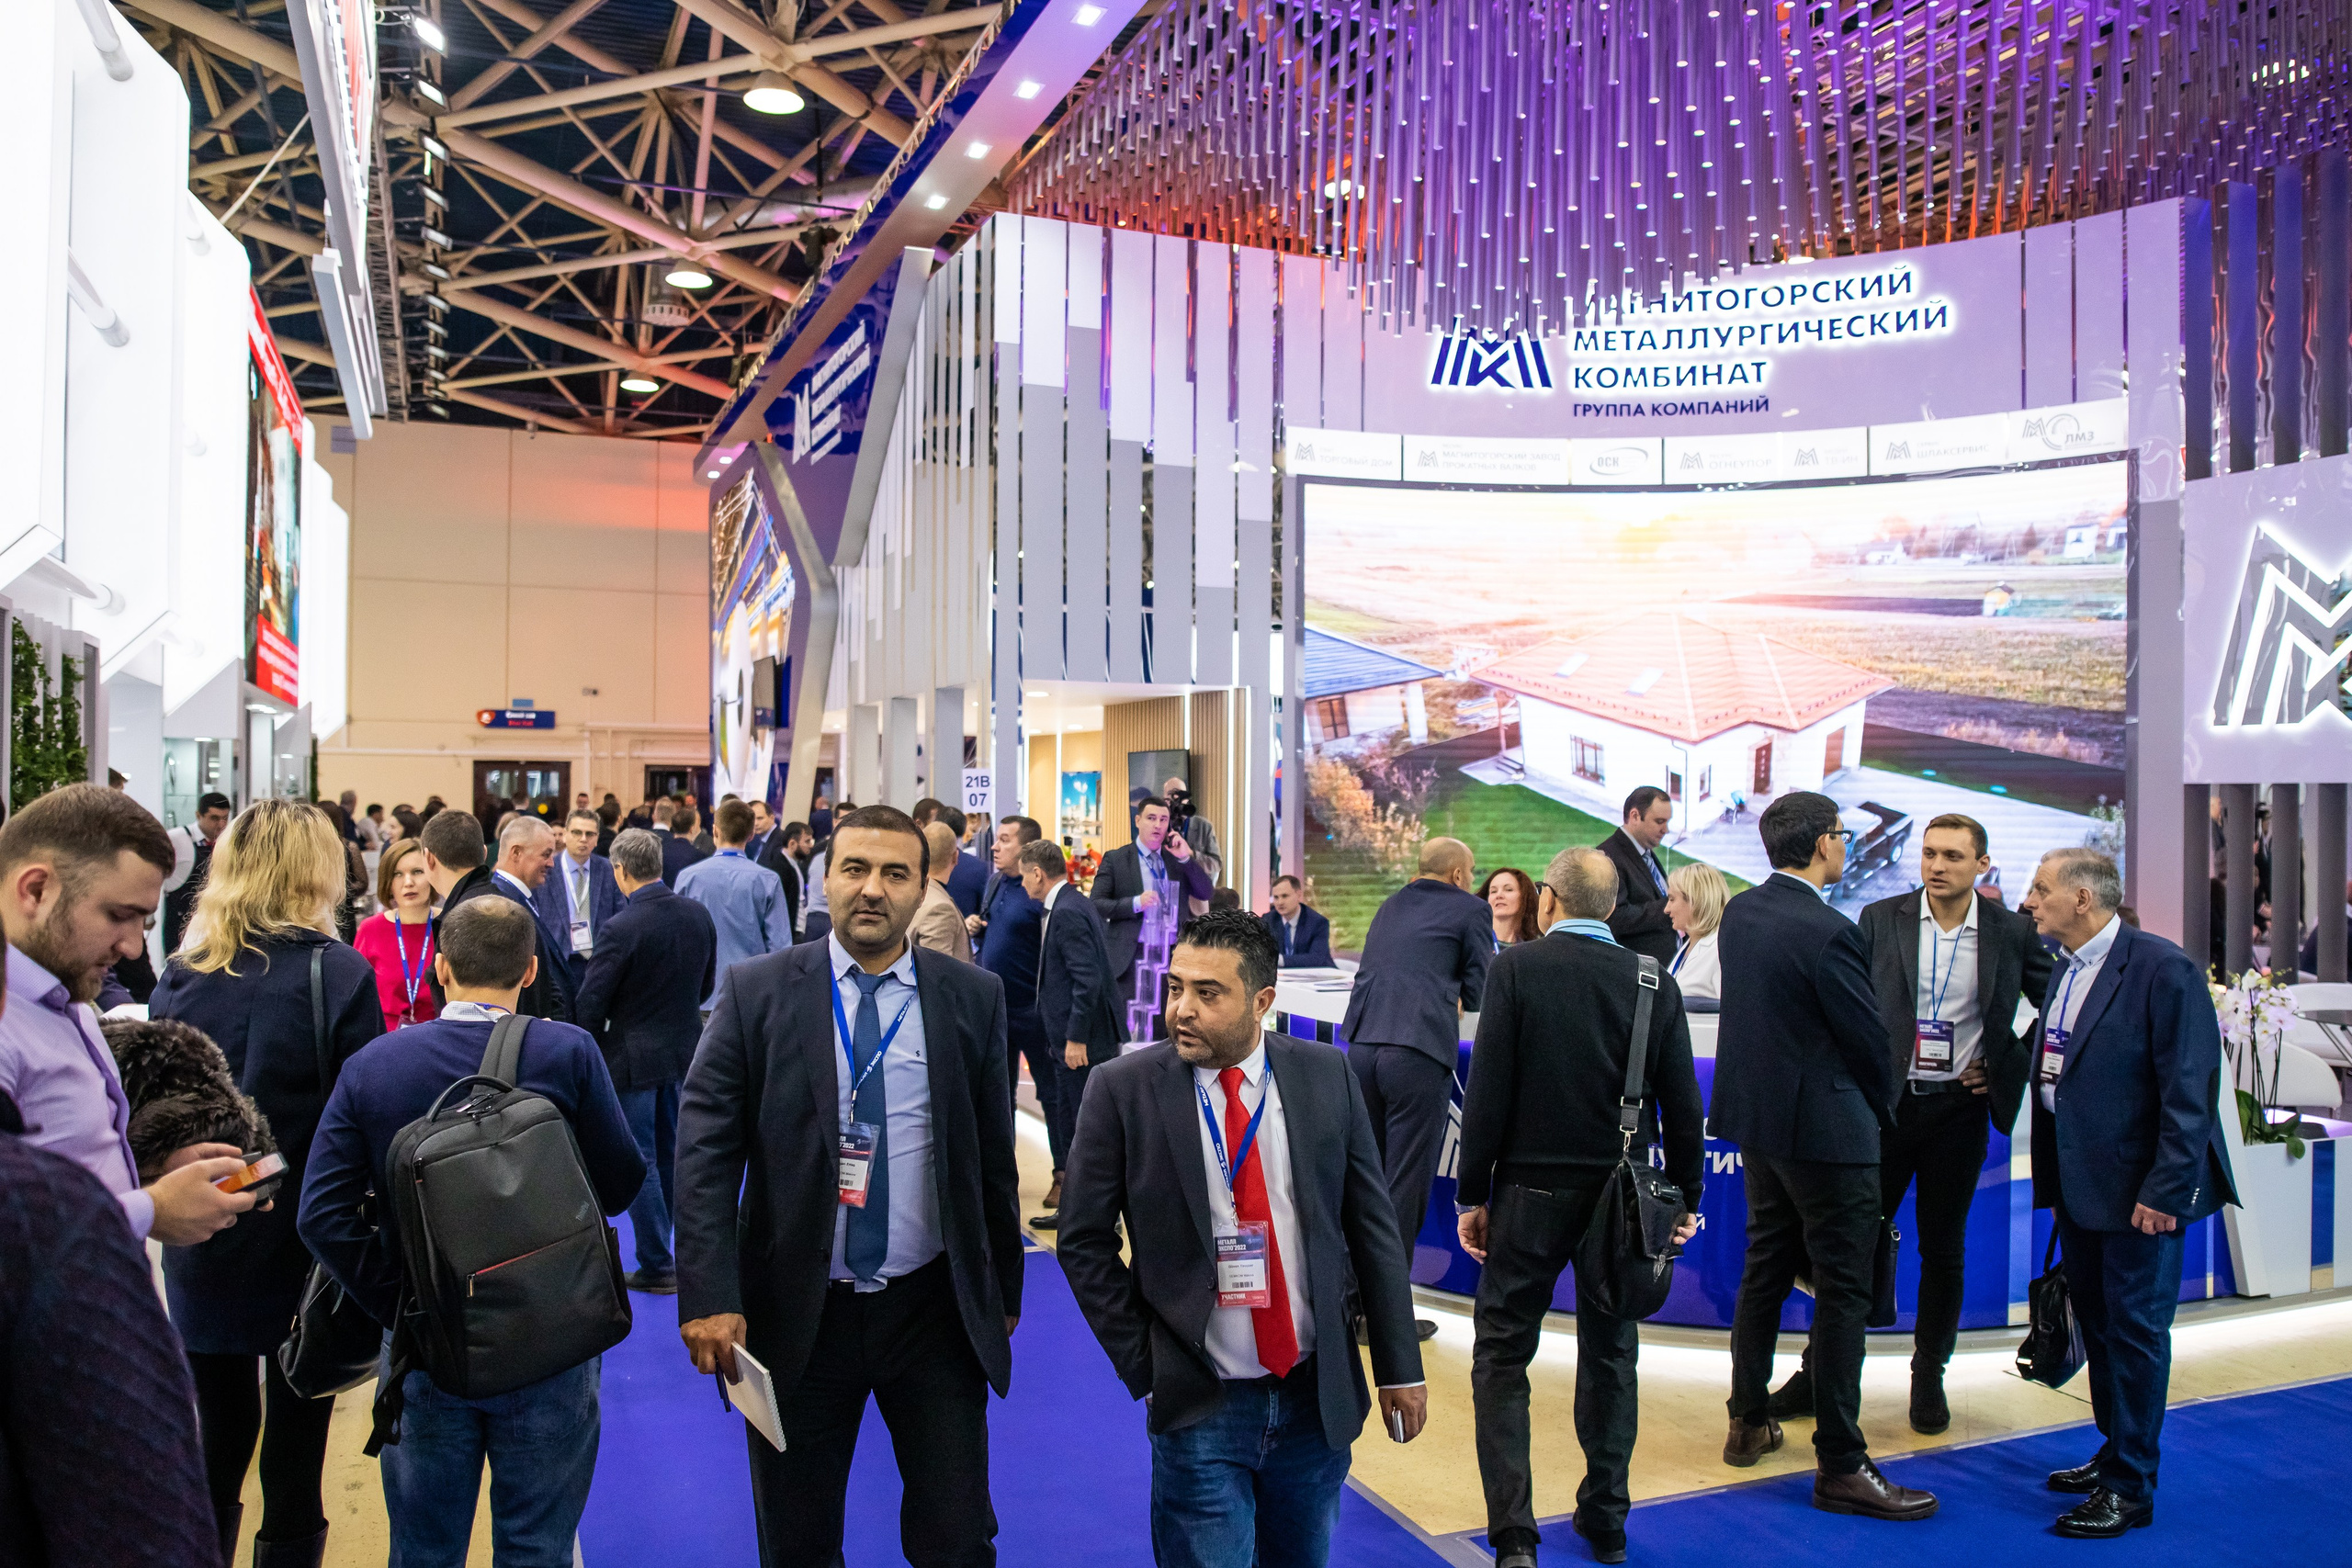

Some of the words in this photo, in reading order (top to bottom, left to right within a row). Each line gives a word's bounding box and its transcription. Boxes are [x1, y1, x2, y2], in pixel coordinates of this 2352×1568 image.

[1587, 265, 1912, 314] НИТОГОРСКИЙ
[1574, 299, 1948, 352] МЕТАЛЛУРГИЧЕСКИЙ
[1574, 362, 1768, 389] КОМБИНАТ
[1573, 402, 1645, 417] ГРУППА
[1652, 395, 1770, 416] КОМПАНИЙ
[2064, 431, 2095, 445] ЛМЗ
[1442, 450, 1527, 460] МАГНИТОГОРСКИЙ
[1529, 453, 1561, 462] ЗАВОД
[1917, 444, 1990, 458] ШЛАКСЕРВИС
[1320, 454, 1368, 466] ТОРГОВЫЙ
[1371, 458, 1393, 468] ДОМ
[1442, 461, 1498, 470] ПРОКАТНЫХ
[1499, 463, 1536, 471] ВАЛКОВ
[1709, 458, 1772, 469] ОГНЕУПОР
[966, 775, 990, 788] 21B
[969, 793, 988, 807] 07
